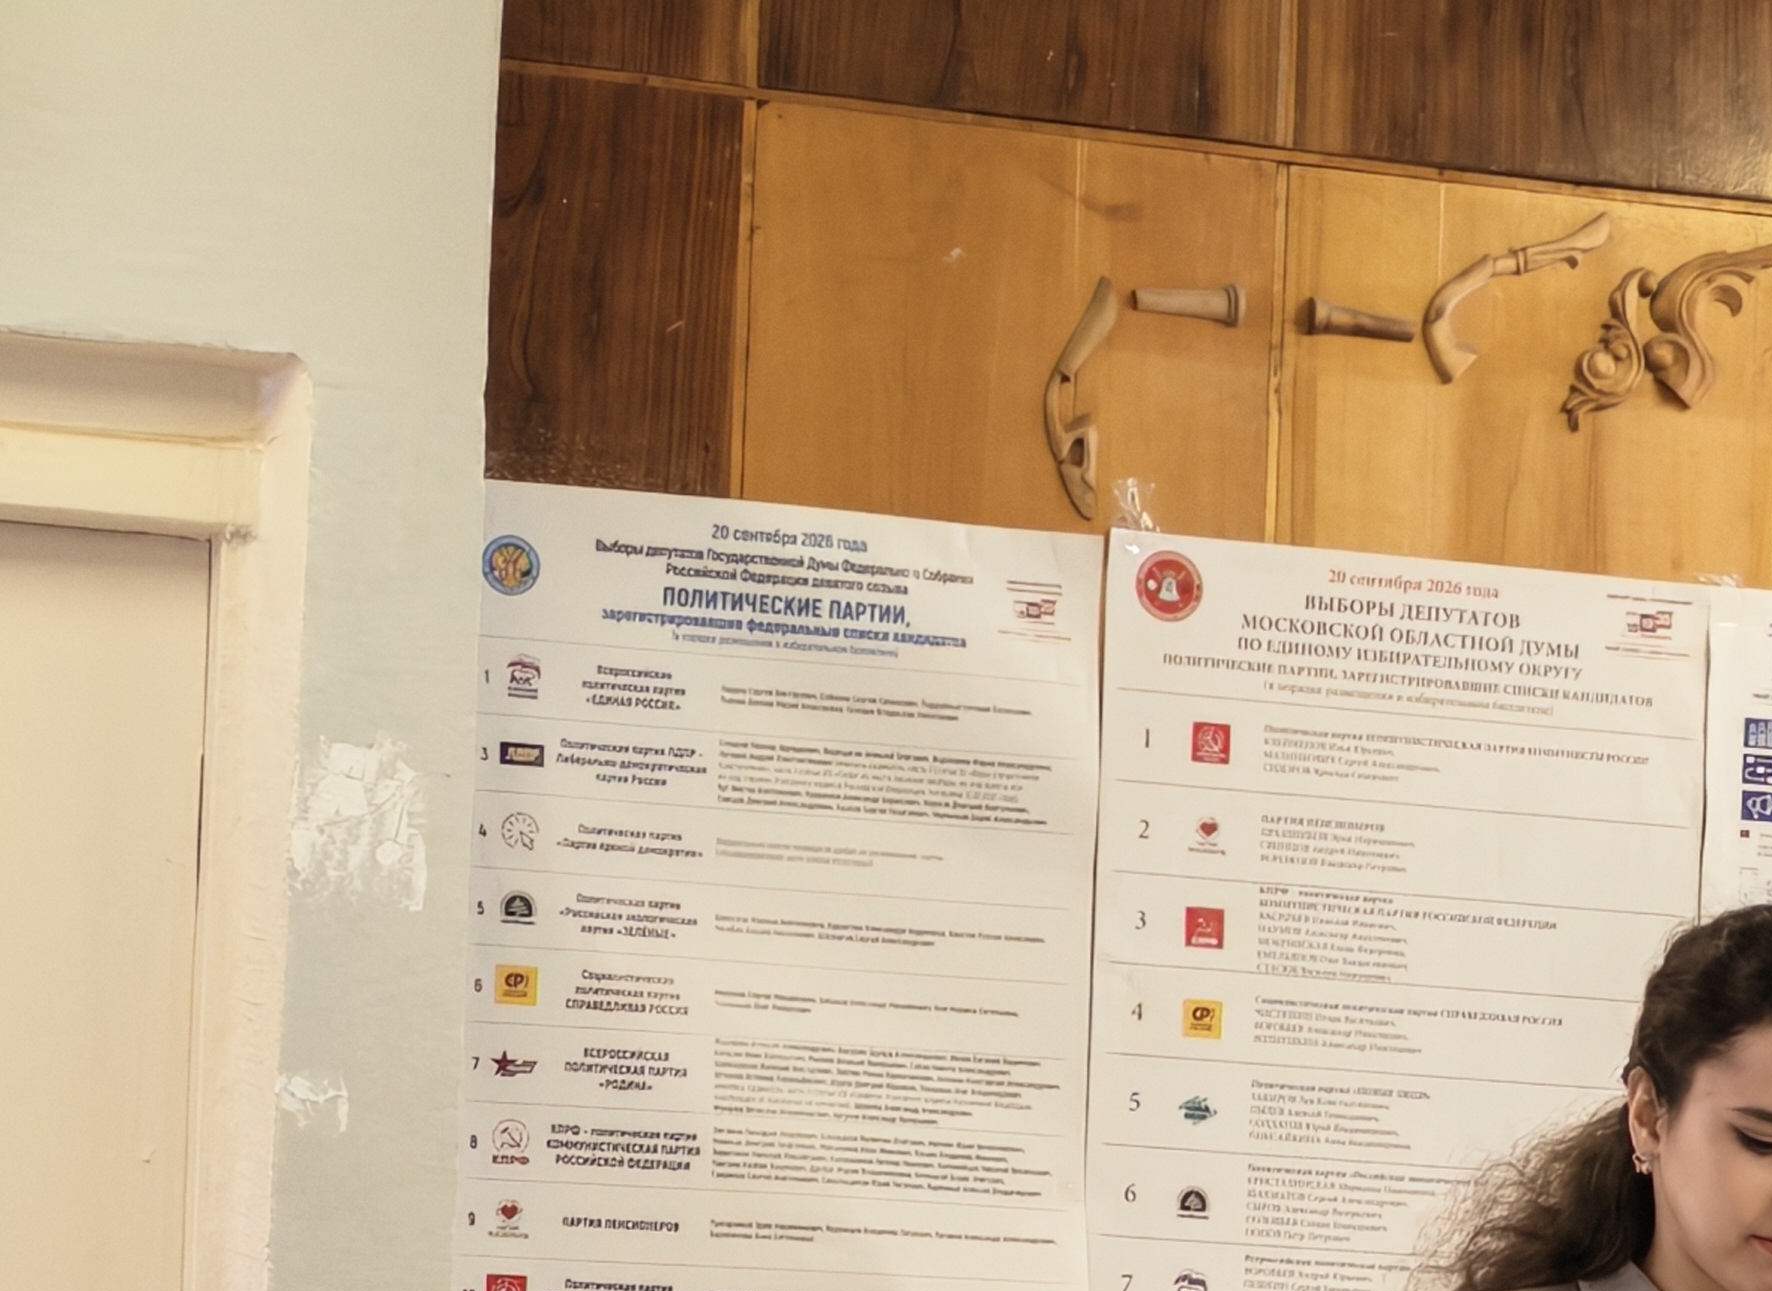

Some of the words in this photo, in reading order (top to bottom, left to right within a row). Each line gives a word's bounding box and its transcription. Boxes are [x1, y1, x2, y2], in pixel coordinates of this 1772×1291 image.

[712, 524, 729, 540] 20
[733, 529, 798, 547] сентября
[837, 538, 868, 552] года
[1328, 569, 1346, 583] 20
[1349, 573, 1422, 594] сентября
[1426, 579, 1462, 595] 2026
[1465, 584, 1500, 598] года
[663, 586, 824, 619] ПОЛИТИЧЕСКИЕ
[829, 600, 911, 628] ПАРТИИ,
[1305, 594, 1395, 618] ВЫБОРЫ
[1399, 603, 1521, 628] ДЕПУТАТОВ
[1241, 614, 1383, 642] МОСКОВСКОЙ
[1389, 626, 1515, 654] ОБЛАСТНОЙ
[1519, 639, 1580, 660] ДУМЫ
[1237, 636, 1262, 651] ПО
[1266, 639, 1353, 660] ЕДИНОМУ
[1357, 648, 1515, 674] ИЗБИРАТЕЛЬНОМУ
[1519, 662, 1583, 681] ОКРУГУ
[484, 670, 489, 683] 1
[1163, 653, 1274, 675] ПОЛИТИЧЕСКИЕ
[1341, 669, 1501, 694] ЗАРЕГИСТРИРОВАВШИЕ
[1504, 684, 1559, 699] СПИСКИ
[1562, 690, 1654, 707] КАНДИДАТОВ
[1143, 728, 1151, 749] 1
[480, 747, 489, 761] 3
[479, 824, 487, 837] 4
[1138, 820, 1150, 840] 2
[476, 901, 485, 915] 5
[1135, 911, 1148, 931] 3
[474, 979, 482, 992] 6
[1130, 1002, 1144, 1022] 4
[471, 1057, 480, 1070] 7
[1128, 1092, 1141, 1112] 5
[470, 1135, 478, 1149] 8
[1124, 1184, 1137, 1203] 6
[468, 1212, 476, 1226] 9
